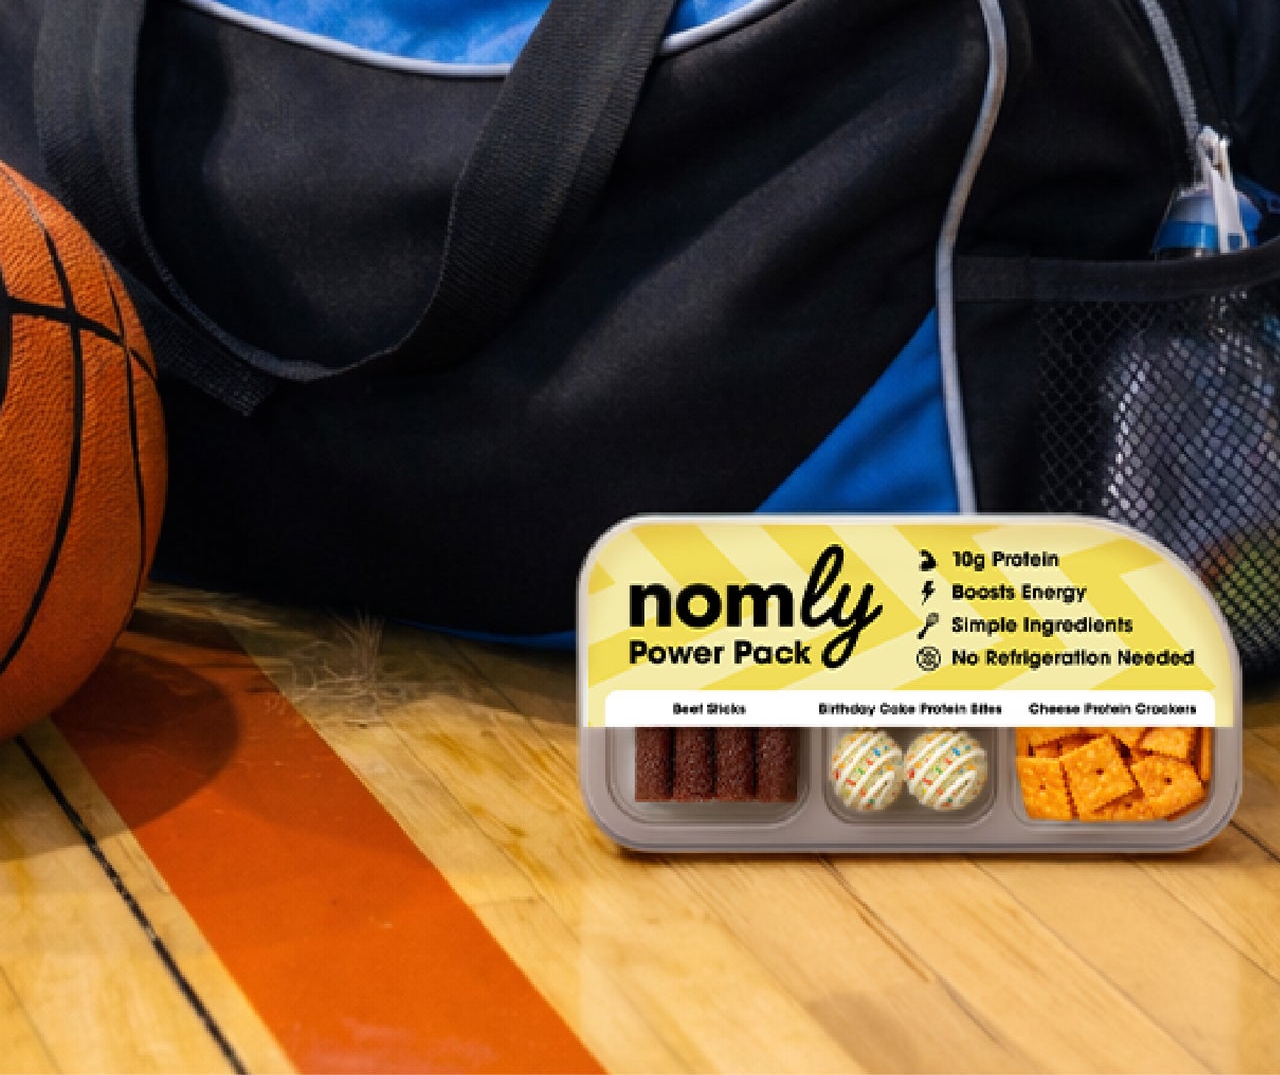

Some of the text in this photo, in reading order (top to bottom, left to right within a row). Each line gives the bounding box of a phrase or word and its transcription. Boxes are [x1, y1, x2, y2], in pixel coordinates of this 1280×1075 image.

[952, 550, 1061, 572] 10g Protein
[951, 582, 1088, 604] Boosts Energy
[629, 543, 884, 669] nomly
[951, 614, 1135, 638] Simple Ingredients
[628, 639, 812, 665] Power Pack
[951, 648, 1196, 670] No Refrigeration Needed
[672, 702, 748, 715] Beef Sticks
[818, 702, 1003, 717] Birthday Cake Protein Bites
[1028, 702, 1198, 715] Cheese Protein Crackers
